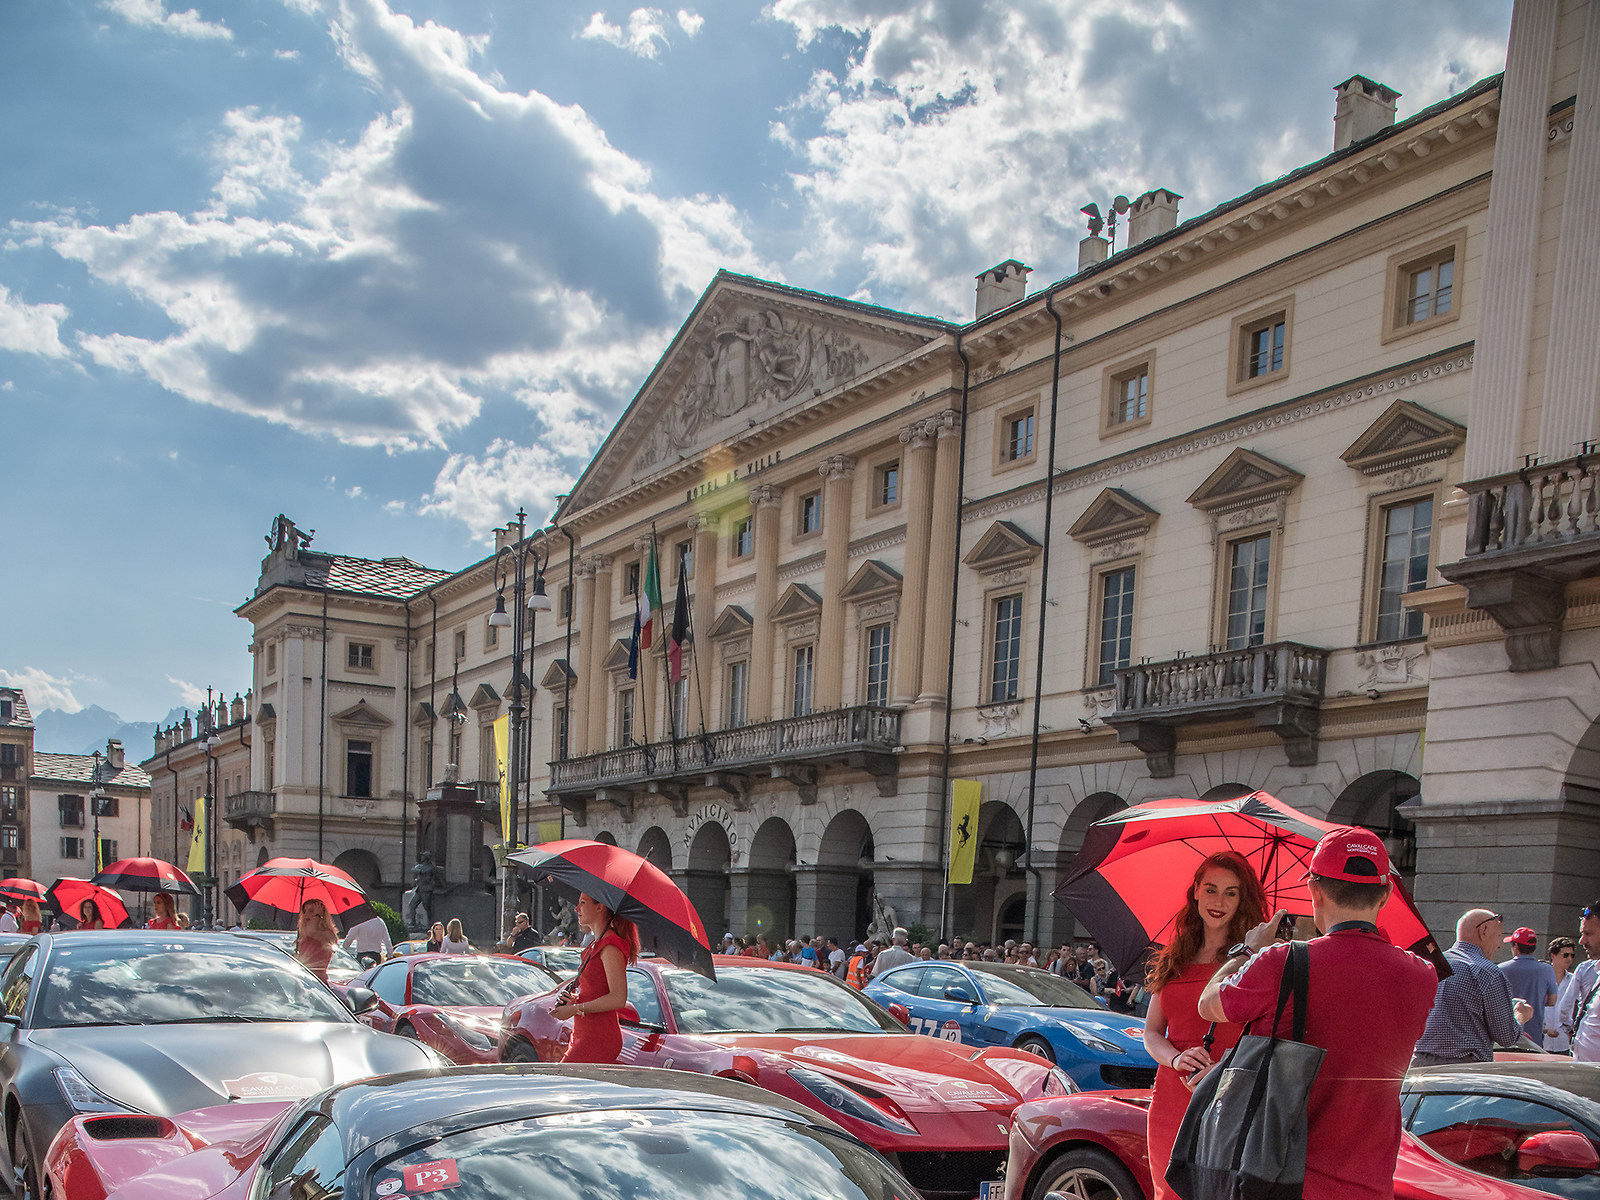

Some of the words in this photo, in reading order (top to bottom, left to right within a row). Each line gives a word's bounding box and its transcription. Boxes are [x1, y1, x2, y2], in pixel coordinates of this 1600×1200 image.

[686, 478, 719, 502] HOTEL
[726, 469, 739, 483] DE
[747, 450, 781, 474] VILLE
[414, 1168, 449, 1187] P3
